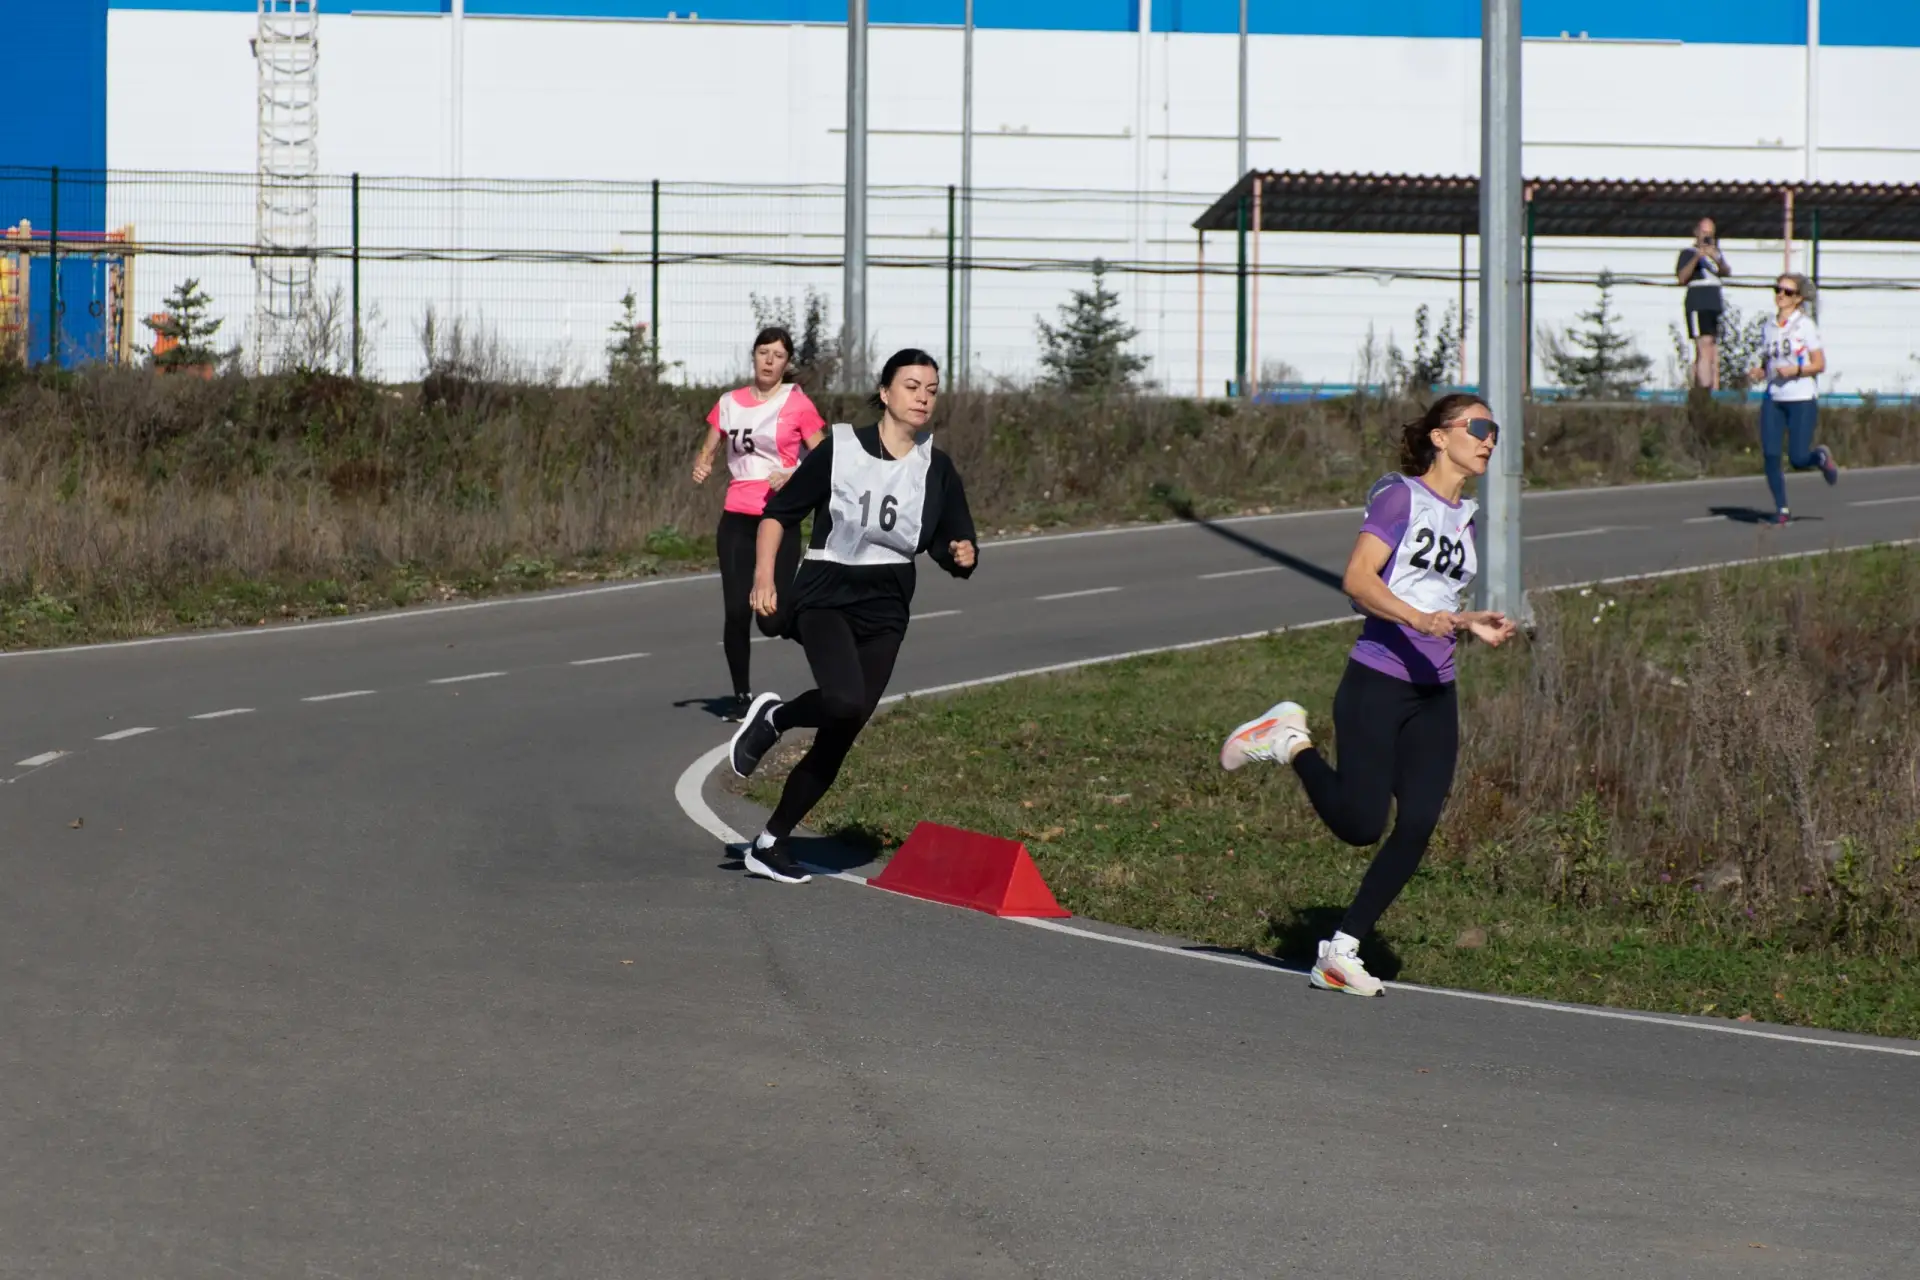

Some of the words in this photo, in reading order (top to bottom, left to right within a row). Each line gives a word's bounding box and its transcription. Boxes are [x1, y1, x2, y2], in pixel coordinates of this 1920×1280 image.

[729, 428, 755, 453] 75
[859, 490, 898, 532] 16
[1409, 527, 1465, 581] 282
